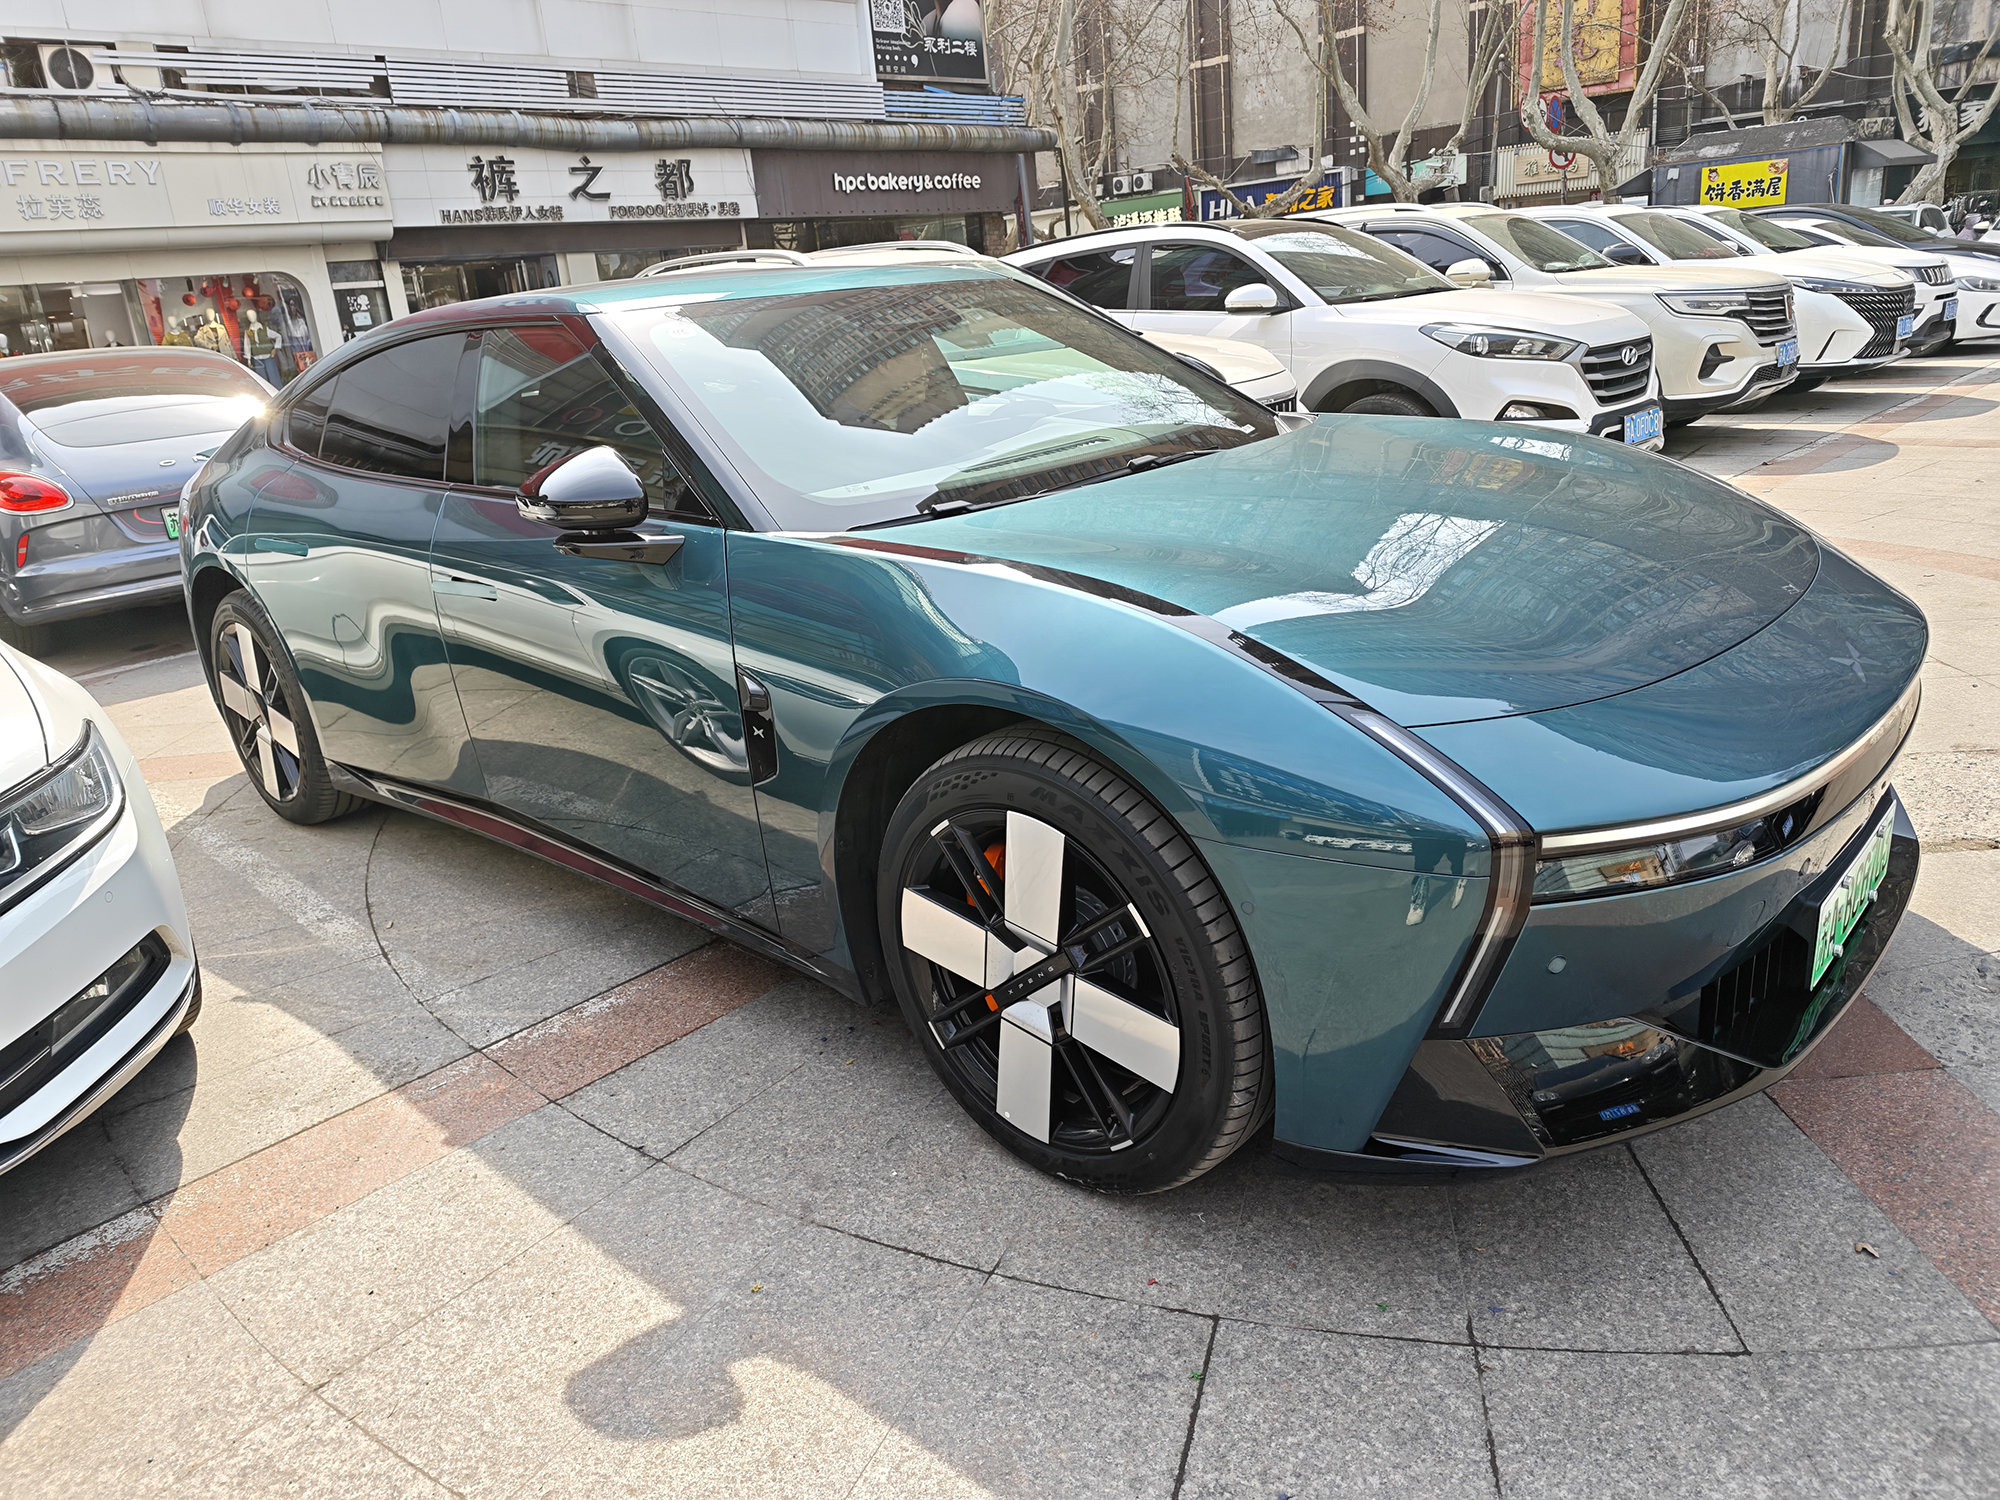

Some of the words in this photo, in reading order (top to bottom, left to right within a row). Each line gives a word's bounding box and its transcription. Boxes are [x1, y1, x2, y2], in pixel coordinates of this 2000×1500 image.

[0, 160, 161, 185] FRERY
[467, 155, 695, 202] 裤之都
[1265, 185, 1335, 213] 之家
[1704, 176, 1782, 202] 饼香满屋
[1007, 965, 1054, 995] XPENG
